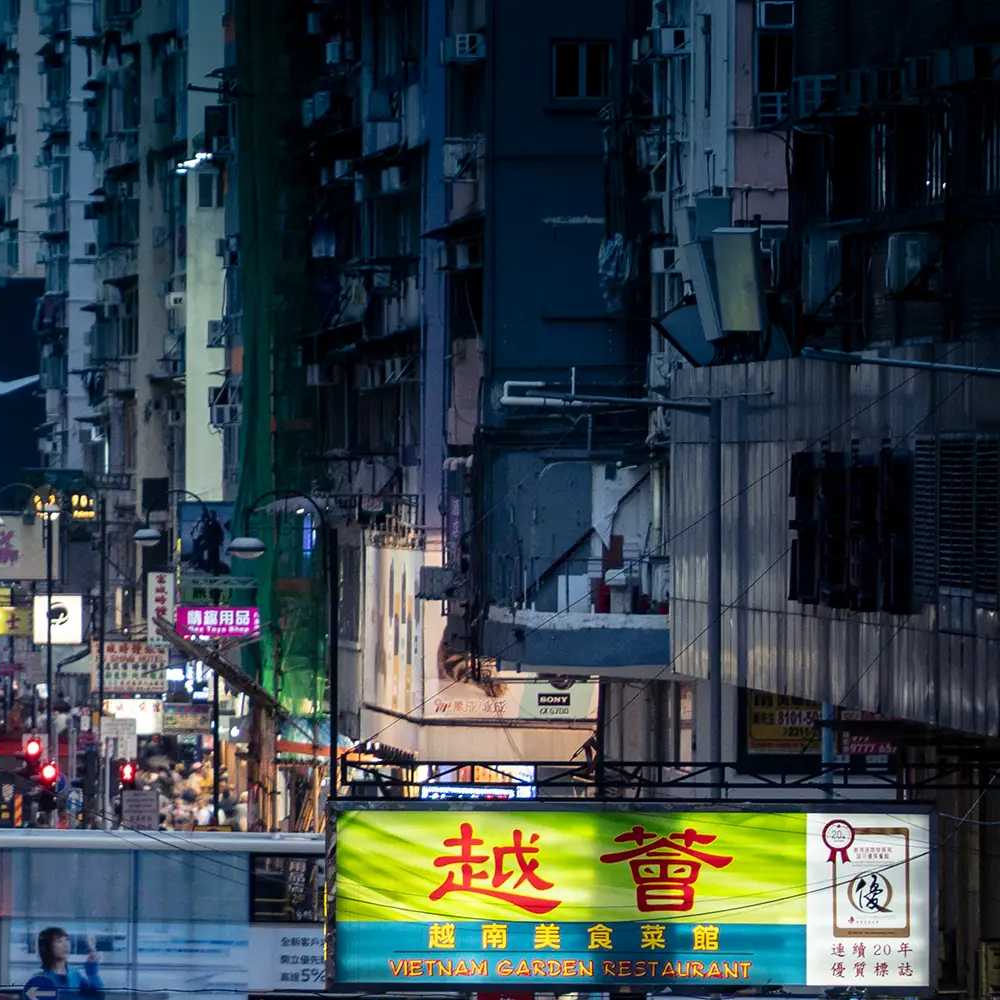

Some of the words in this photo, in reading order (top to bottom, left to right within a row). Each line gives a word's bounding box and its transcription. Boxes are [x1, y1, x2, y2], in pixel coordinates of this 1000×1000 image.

[855, 874, 893, 912] 優
[428, 923, 720, 951] 越南美食菜館
[389, 959, 488, 978] VIETNAM
[496, 959, 593, 977] GARDEN
[603, 961, 752, 980] RESTAURANT
